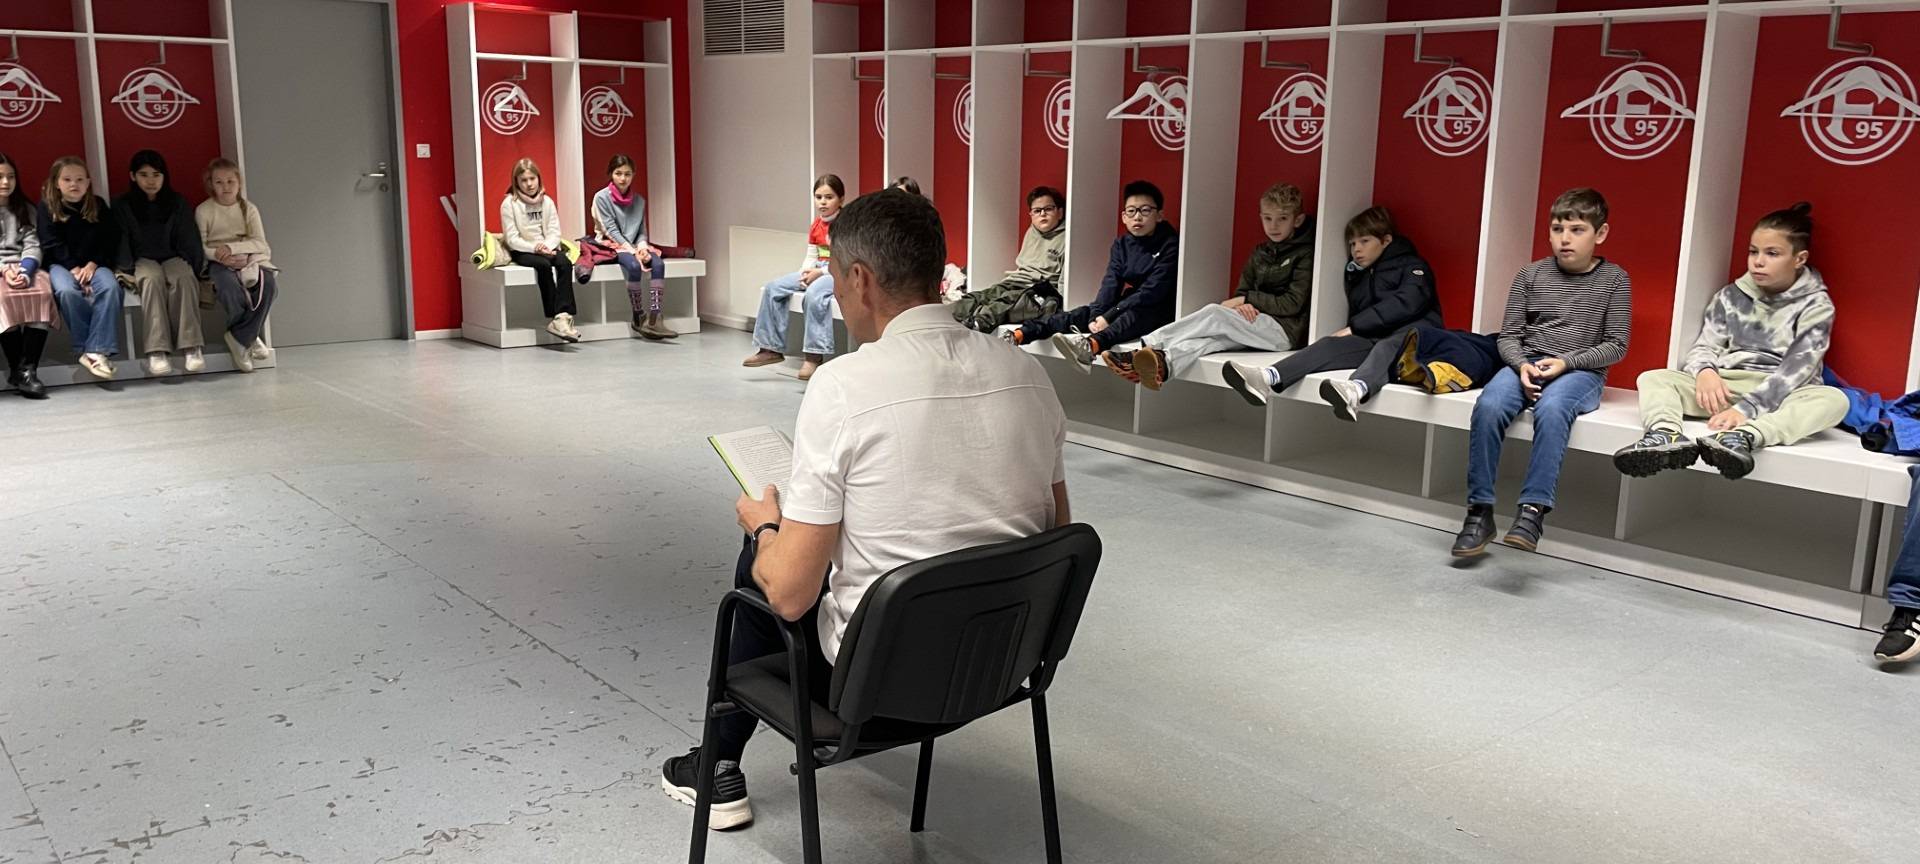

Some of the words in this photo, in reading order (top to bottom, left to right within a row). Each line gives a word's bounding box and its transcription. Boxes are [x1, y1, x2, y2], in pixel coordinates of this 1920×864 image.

[9, 101, 27, 112] 95
[153, 103, 169, 114] 95
[506, 113, 519, 122] 95
[602, 116, 613, 125] 95
[1301, 121, 1317, 134] 95
[1453, 120, 1473, 135] 95
[1634, 120, 1658, 137] 95
[1855, 121, 1884, 139] 95
